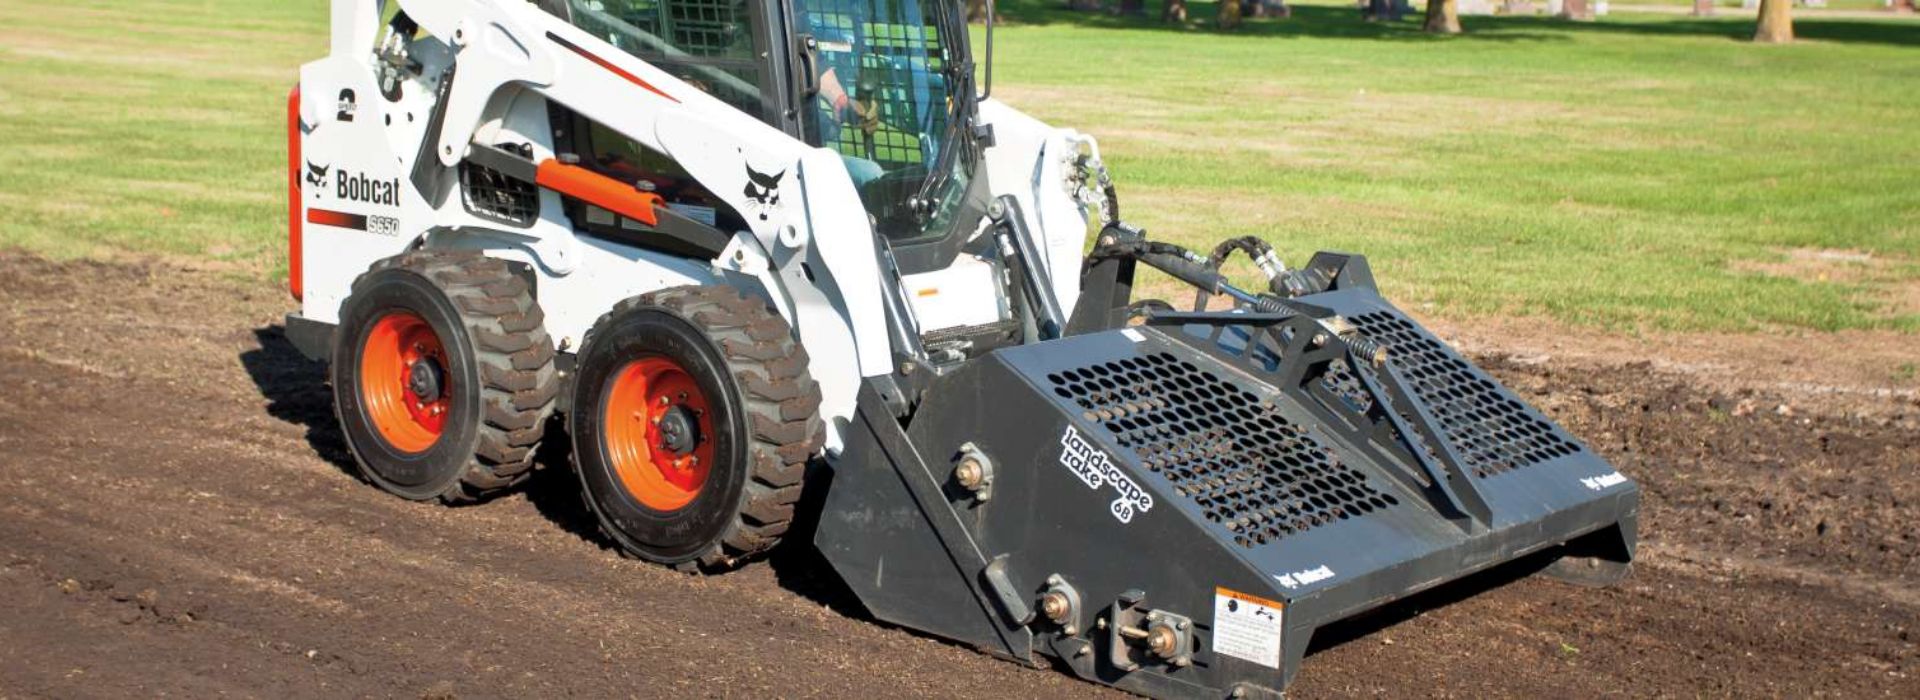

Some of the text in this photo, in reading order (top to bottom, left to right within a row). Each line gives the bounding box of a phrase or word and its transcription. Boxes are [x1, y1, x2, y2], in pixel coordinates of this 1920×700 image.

[337, 88, 356, 122] 2
[337, 169, 400, 207] Bobcat
[369, 214, 400, 237] S650
[1062, 450, 1101, 487] rake
[1063, 427, 1151, 510] landscape
[1113, 502, 1131, 520] 6B
